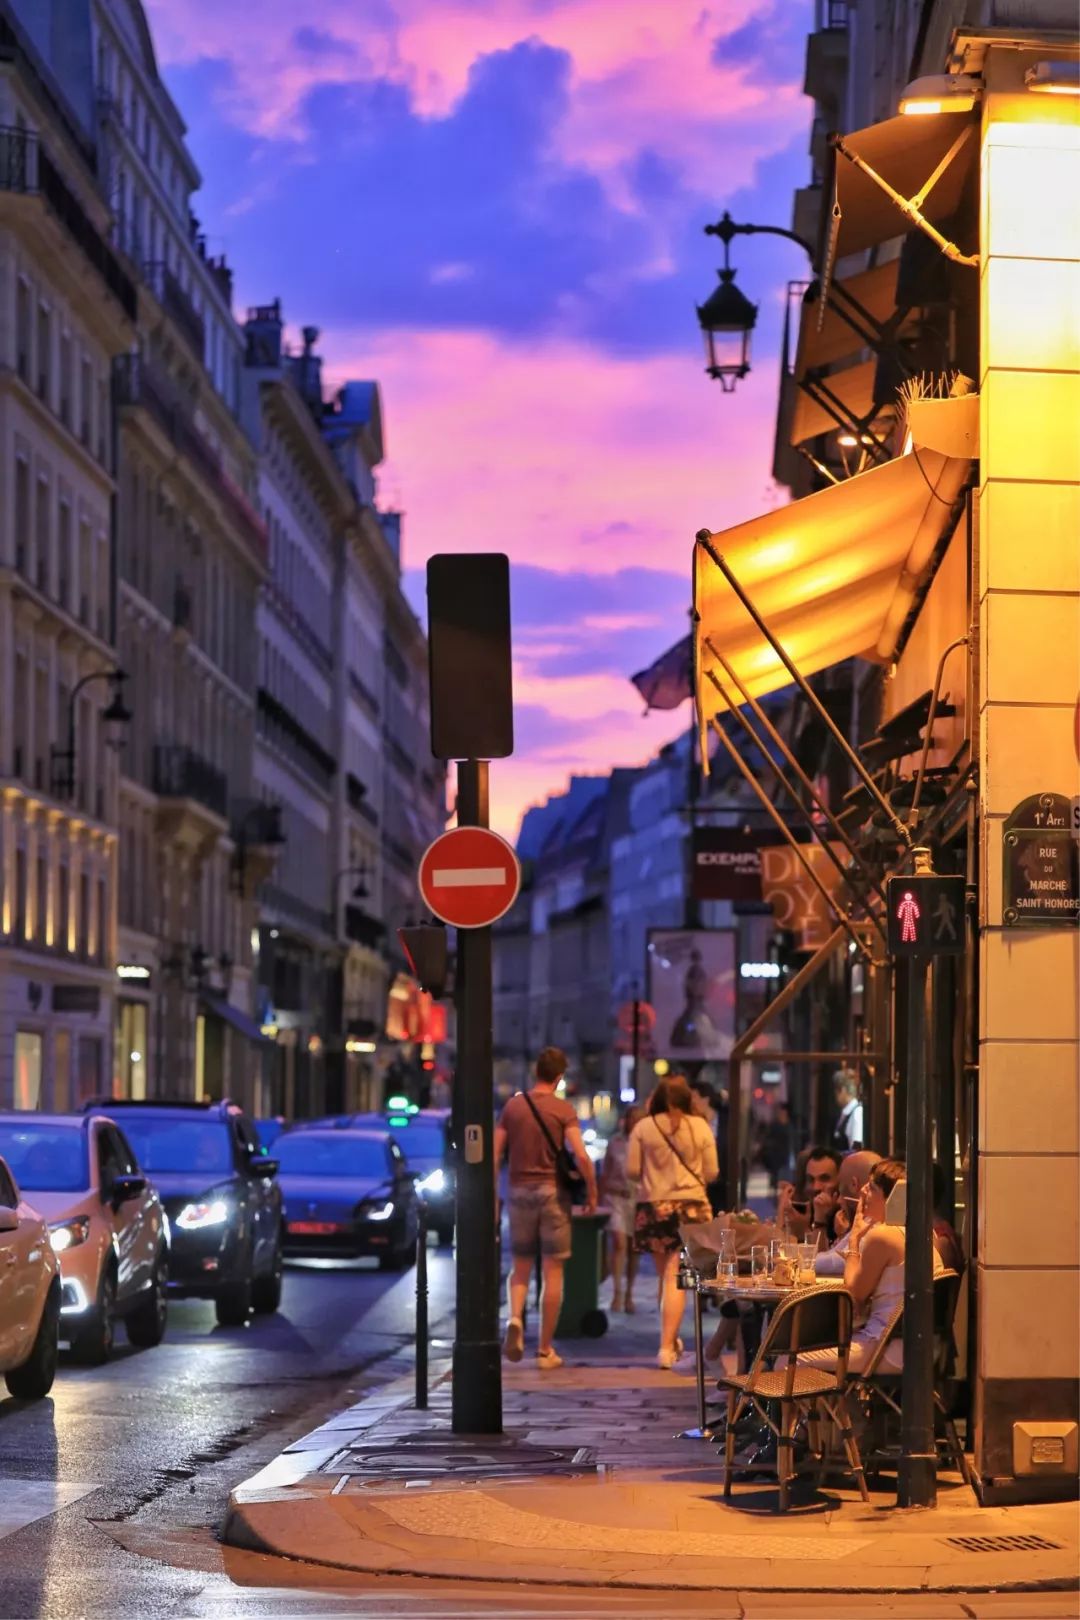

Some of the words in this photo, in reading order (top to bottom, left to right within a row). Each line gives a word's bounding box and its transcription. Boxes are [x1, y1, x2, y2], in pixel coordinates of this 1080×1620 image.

[1039, 848, 1057, 858] RUE
[1030, 880, 1067, 890] MARCHÉ
[1016, 898, 1042, 908] SAINT
